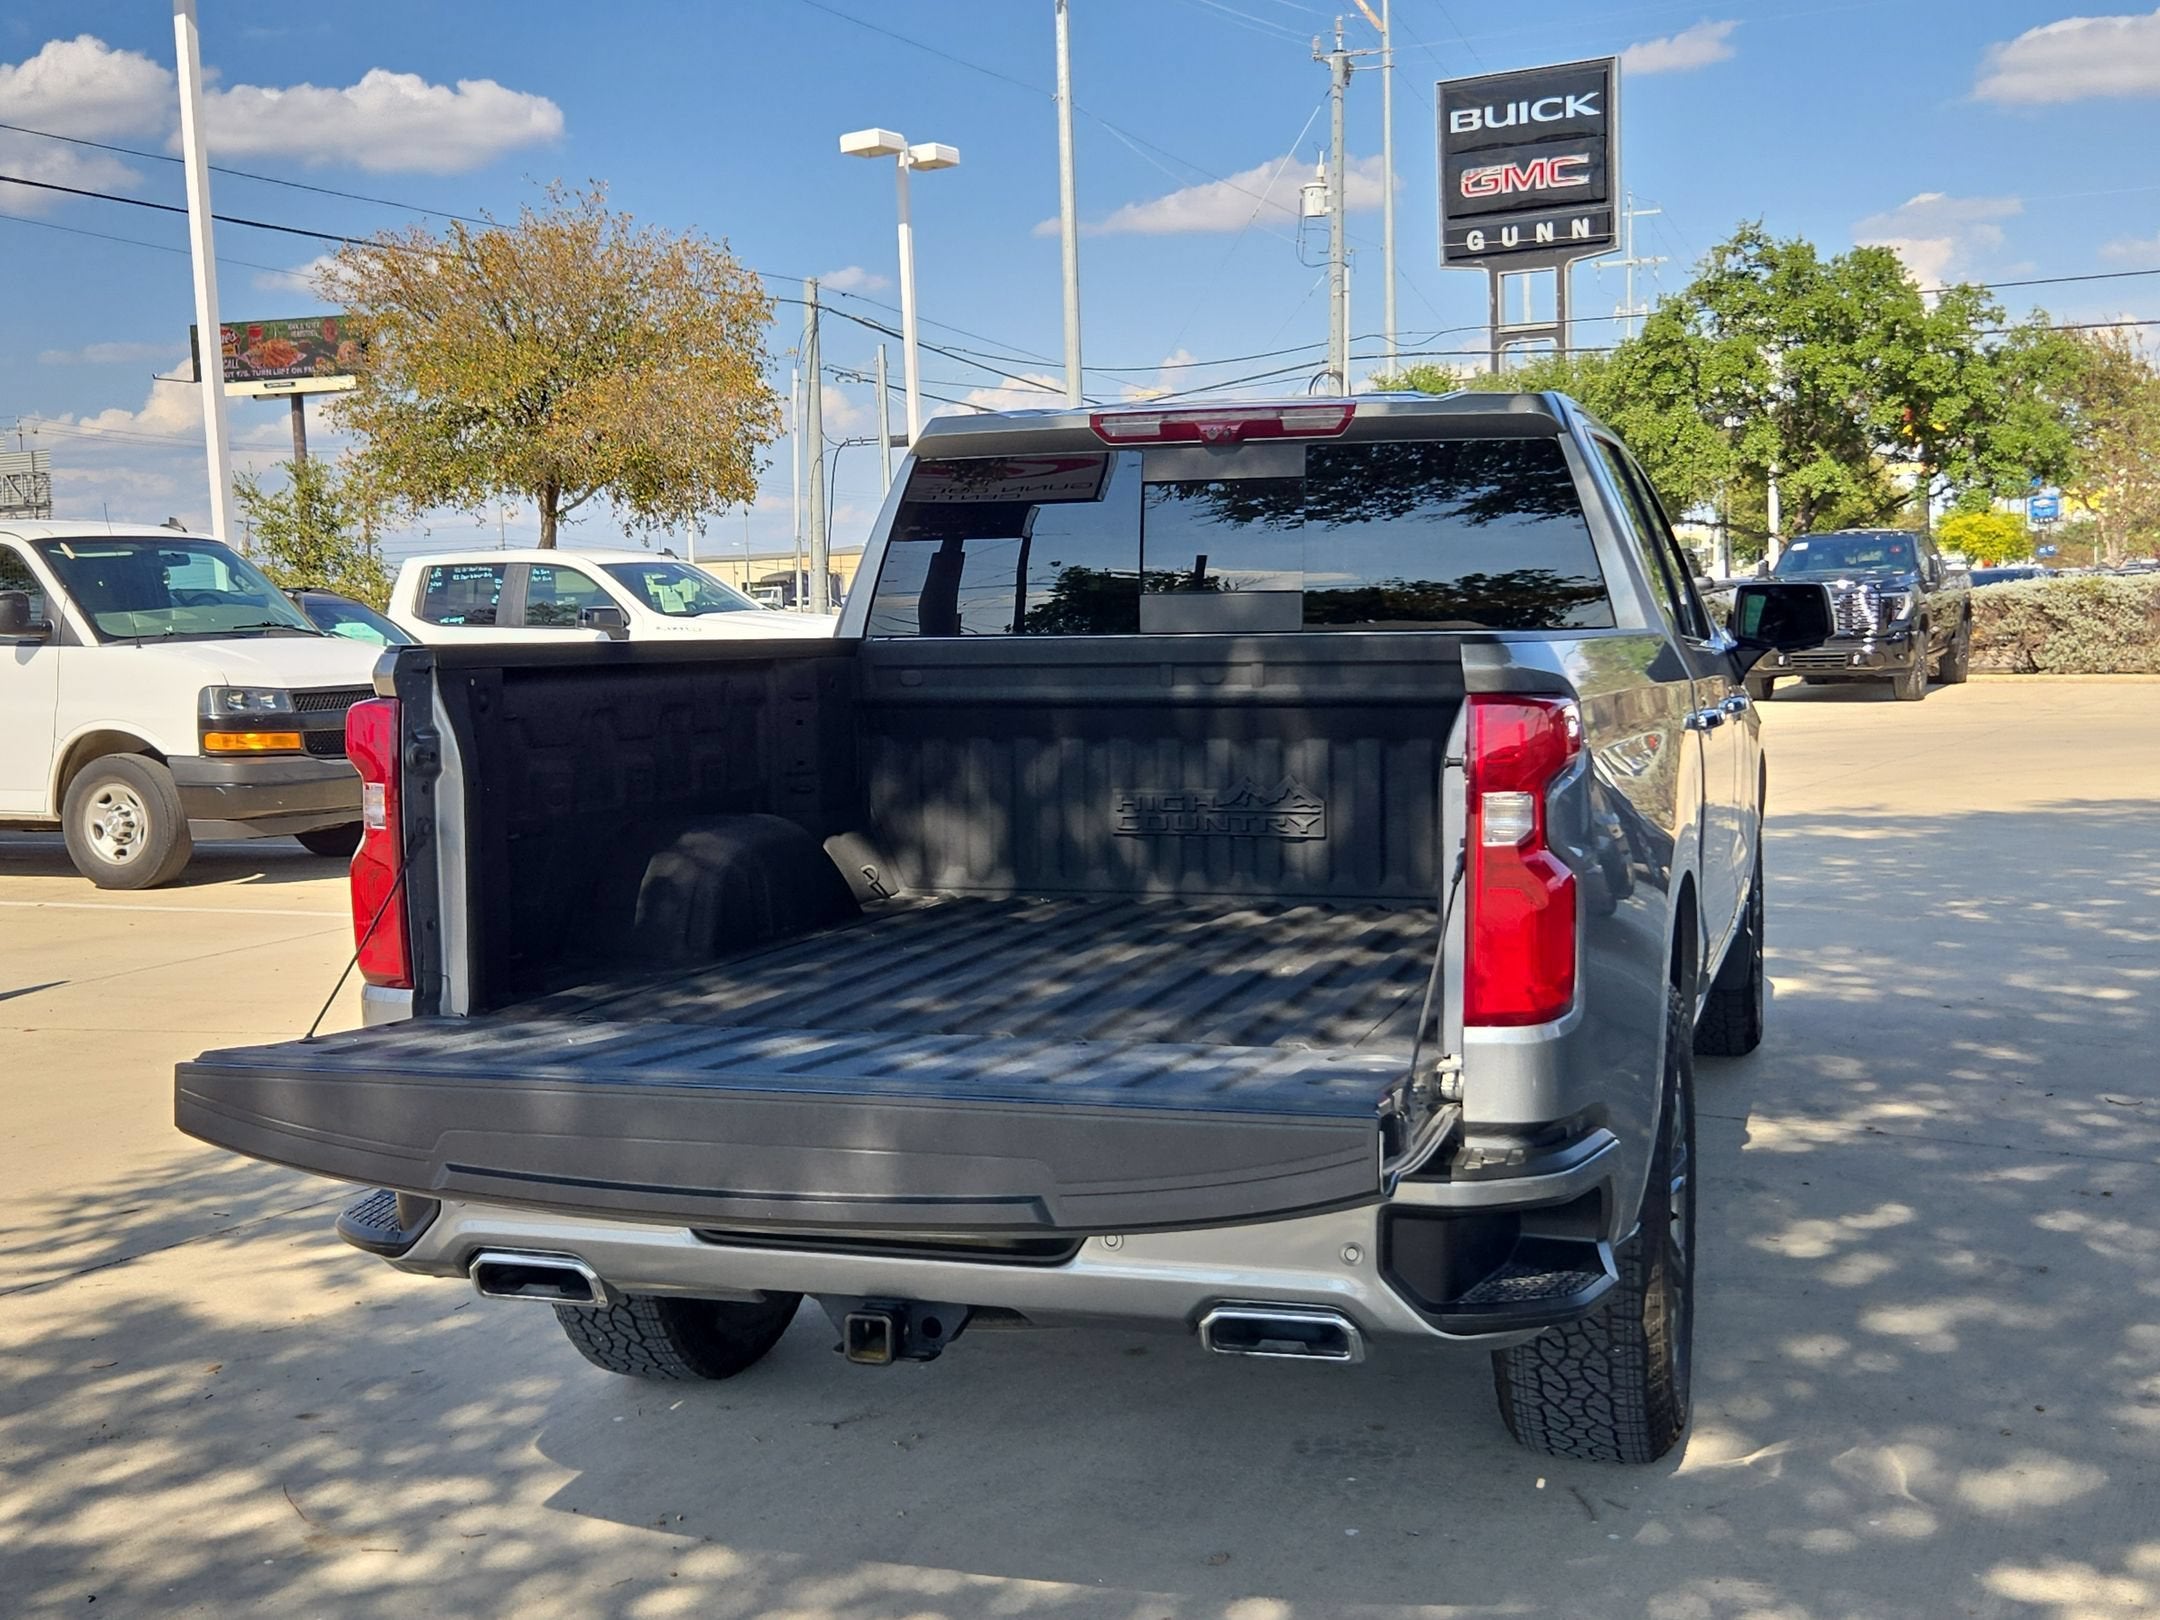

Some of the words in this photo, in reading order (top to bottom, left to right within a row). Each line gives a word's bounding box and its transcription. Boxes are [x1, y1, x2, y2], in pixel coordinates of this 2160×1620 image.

[1450, 92, 1600, 134] BUICK
[1460, 153, 1590, 198] GMC
[1466, 218, 1590, 251] GUNN
[1115, 790, 1218, 812] HIGH
[1115, 813, 1321, 834] COUNTRY
